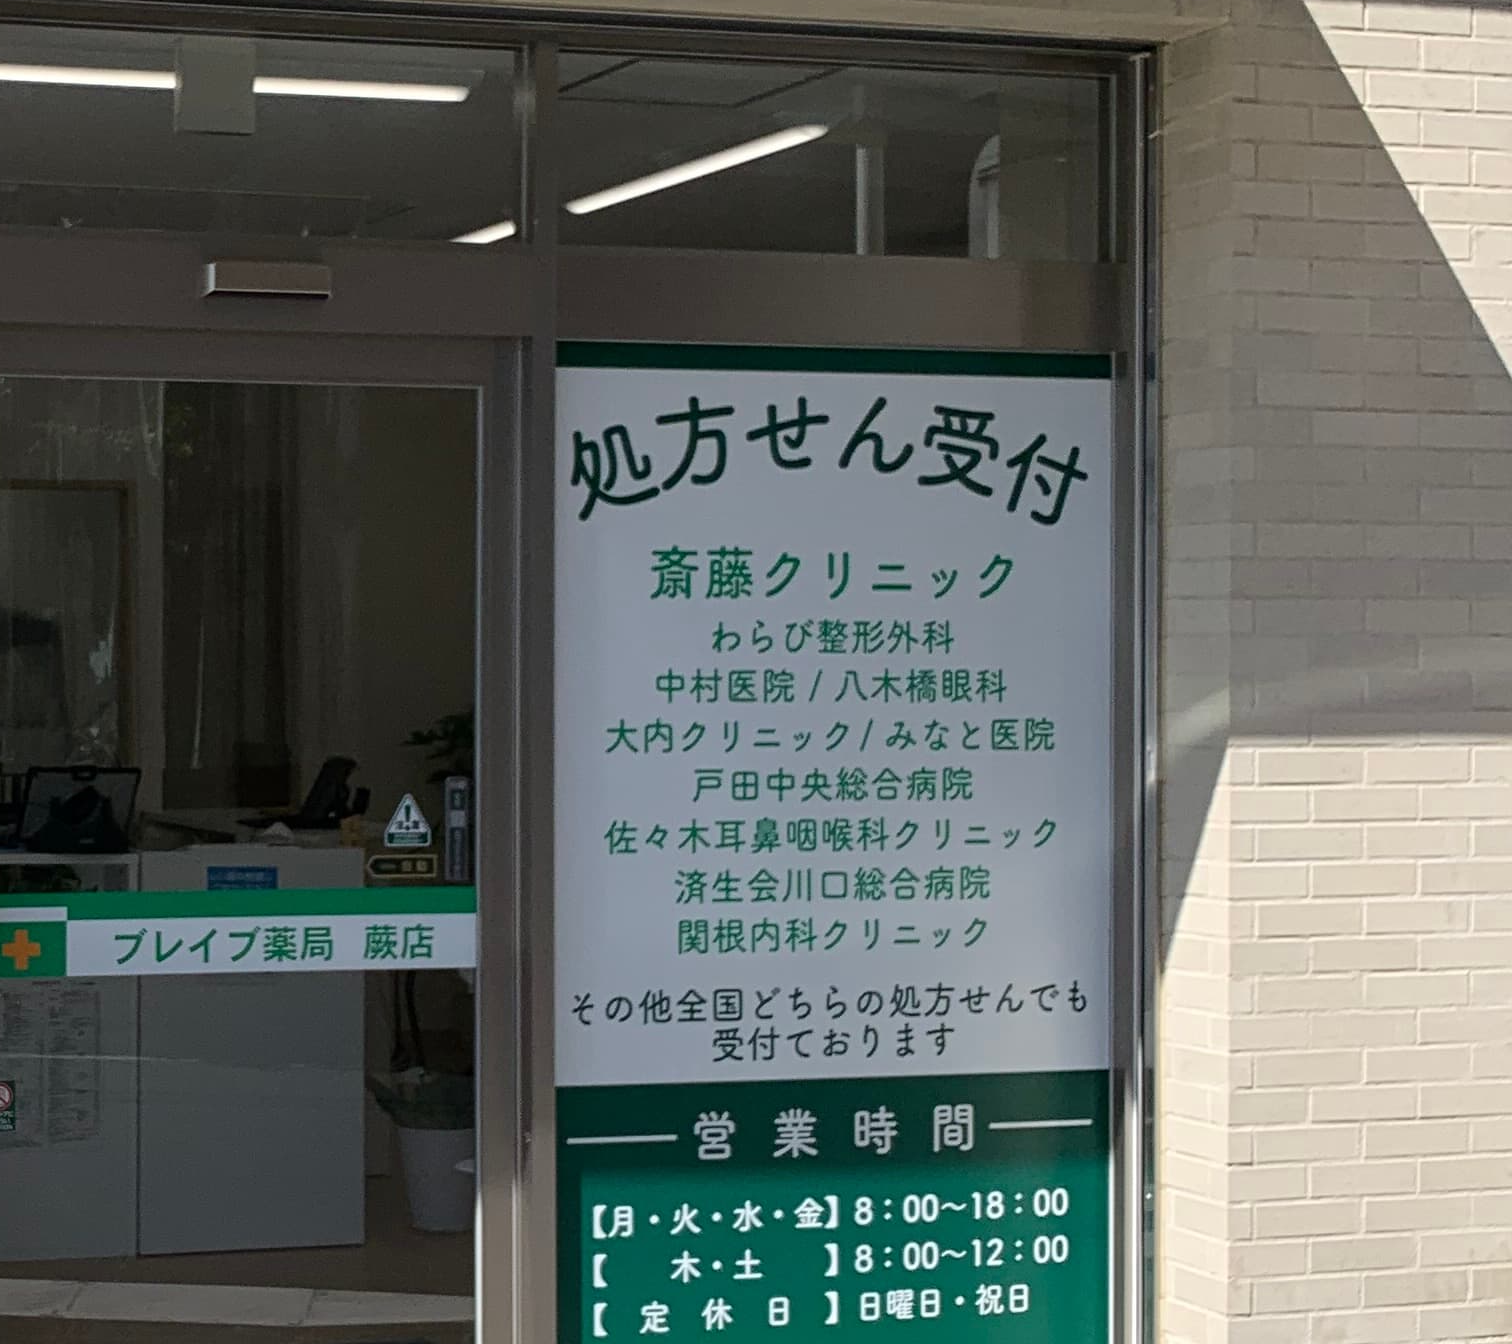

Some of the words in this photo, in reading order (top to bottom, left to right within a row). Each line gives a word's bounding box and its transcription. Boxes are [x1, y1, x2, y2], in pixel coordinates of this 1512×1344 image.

[571, 397, 1088, 525] 処方せん受付
[651, 546, 1013, 599] 斎藤クリニック
[712, 620, 954, 654] わらび整形外科
[693, 767, 972, 802] 戸田中央総合病院
[604, 817, 1056, 854] 佐々木耳鼻咽喉科クリニック
[675, 866, 989, 904] 済生会川口総合病院
[114, 926, 334, 965] ブレイブ薬局
[364, 924, 434, 959] 蕨店
[679, 918, 986, 954] 関根内科クリニック
[571, 980, 1087, 1025] その他全国どちらの処方せんでも
[711, 1022, 955, 1062] 受付ております
[694, 1104, 973, 1159] 営業時間
